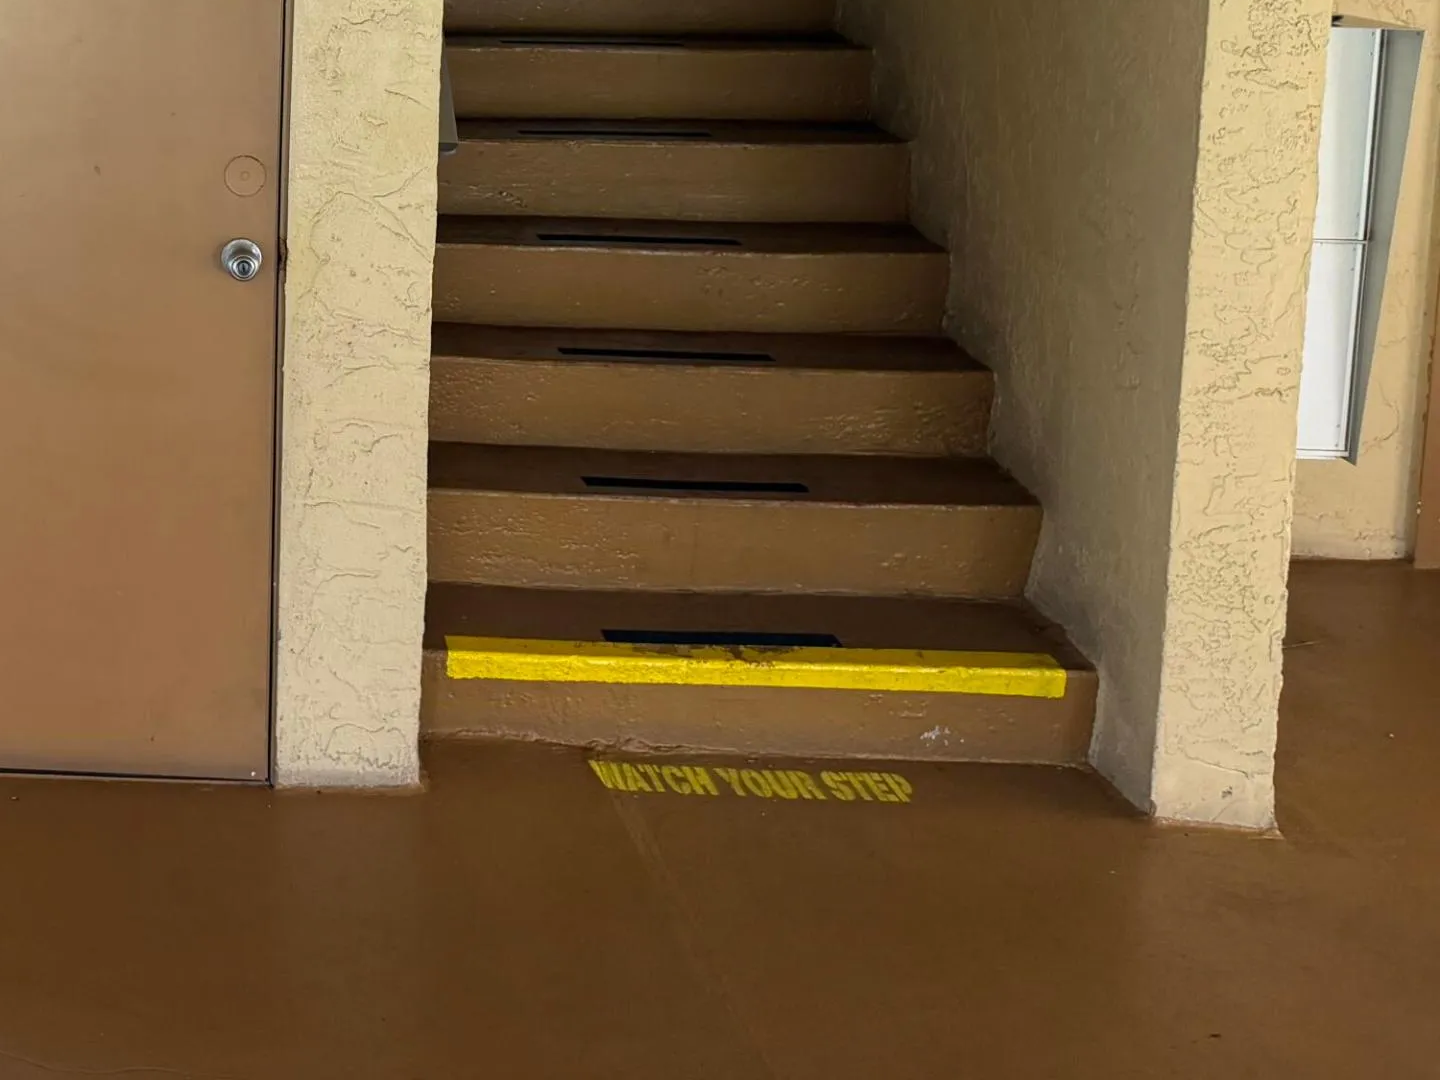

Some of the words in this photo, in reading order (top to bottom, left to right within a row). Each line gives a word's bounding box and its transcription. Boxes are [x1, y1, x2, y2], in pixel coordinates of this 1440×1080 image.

[587, 759, 719, 795] WATCH
[713, 767, 828, 800] YOUR
[819, 769, 913, 803] STEP
